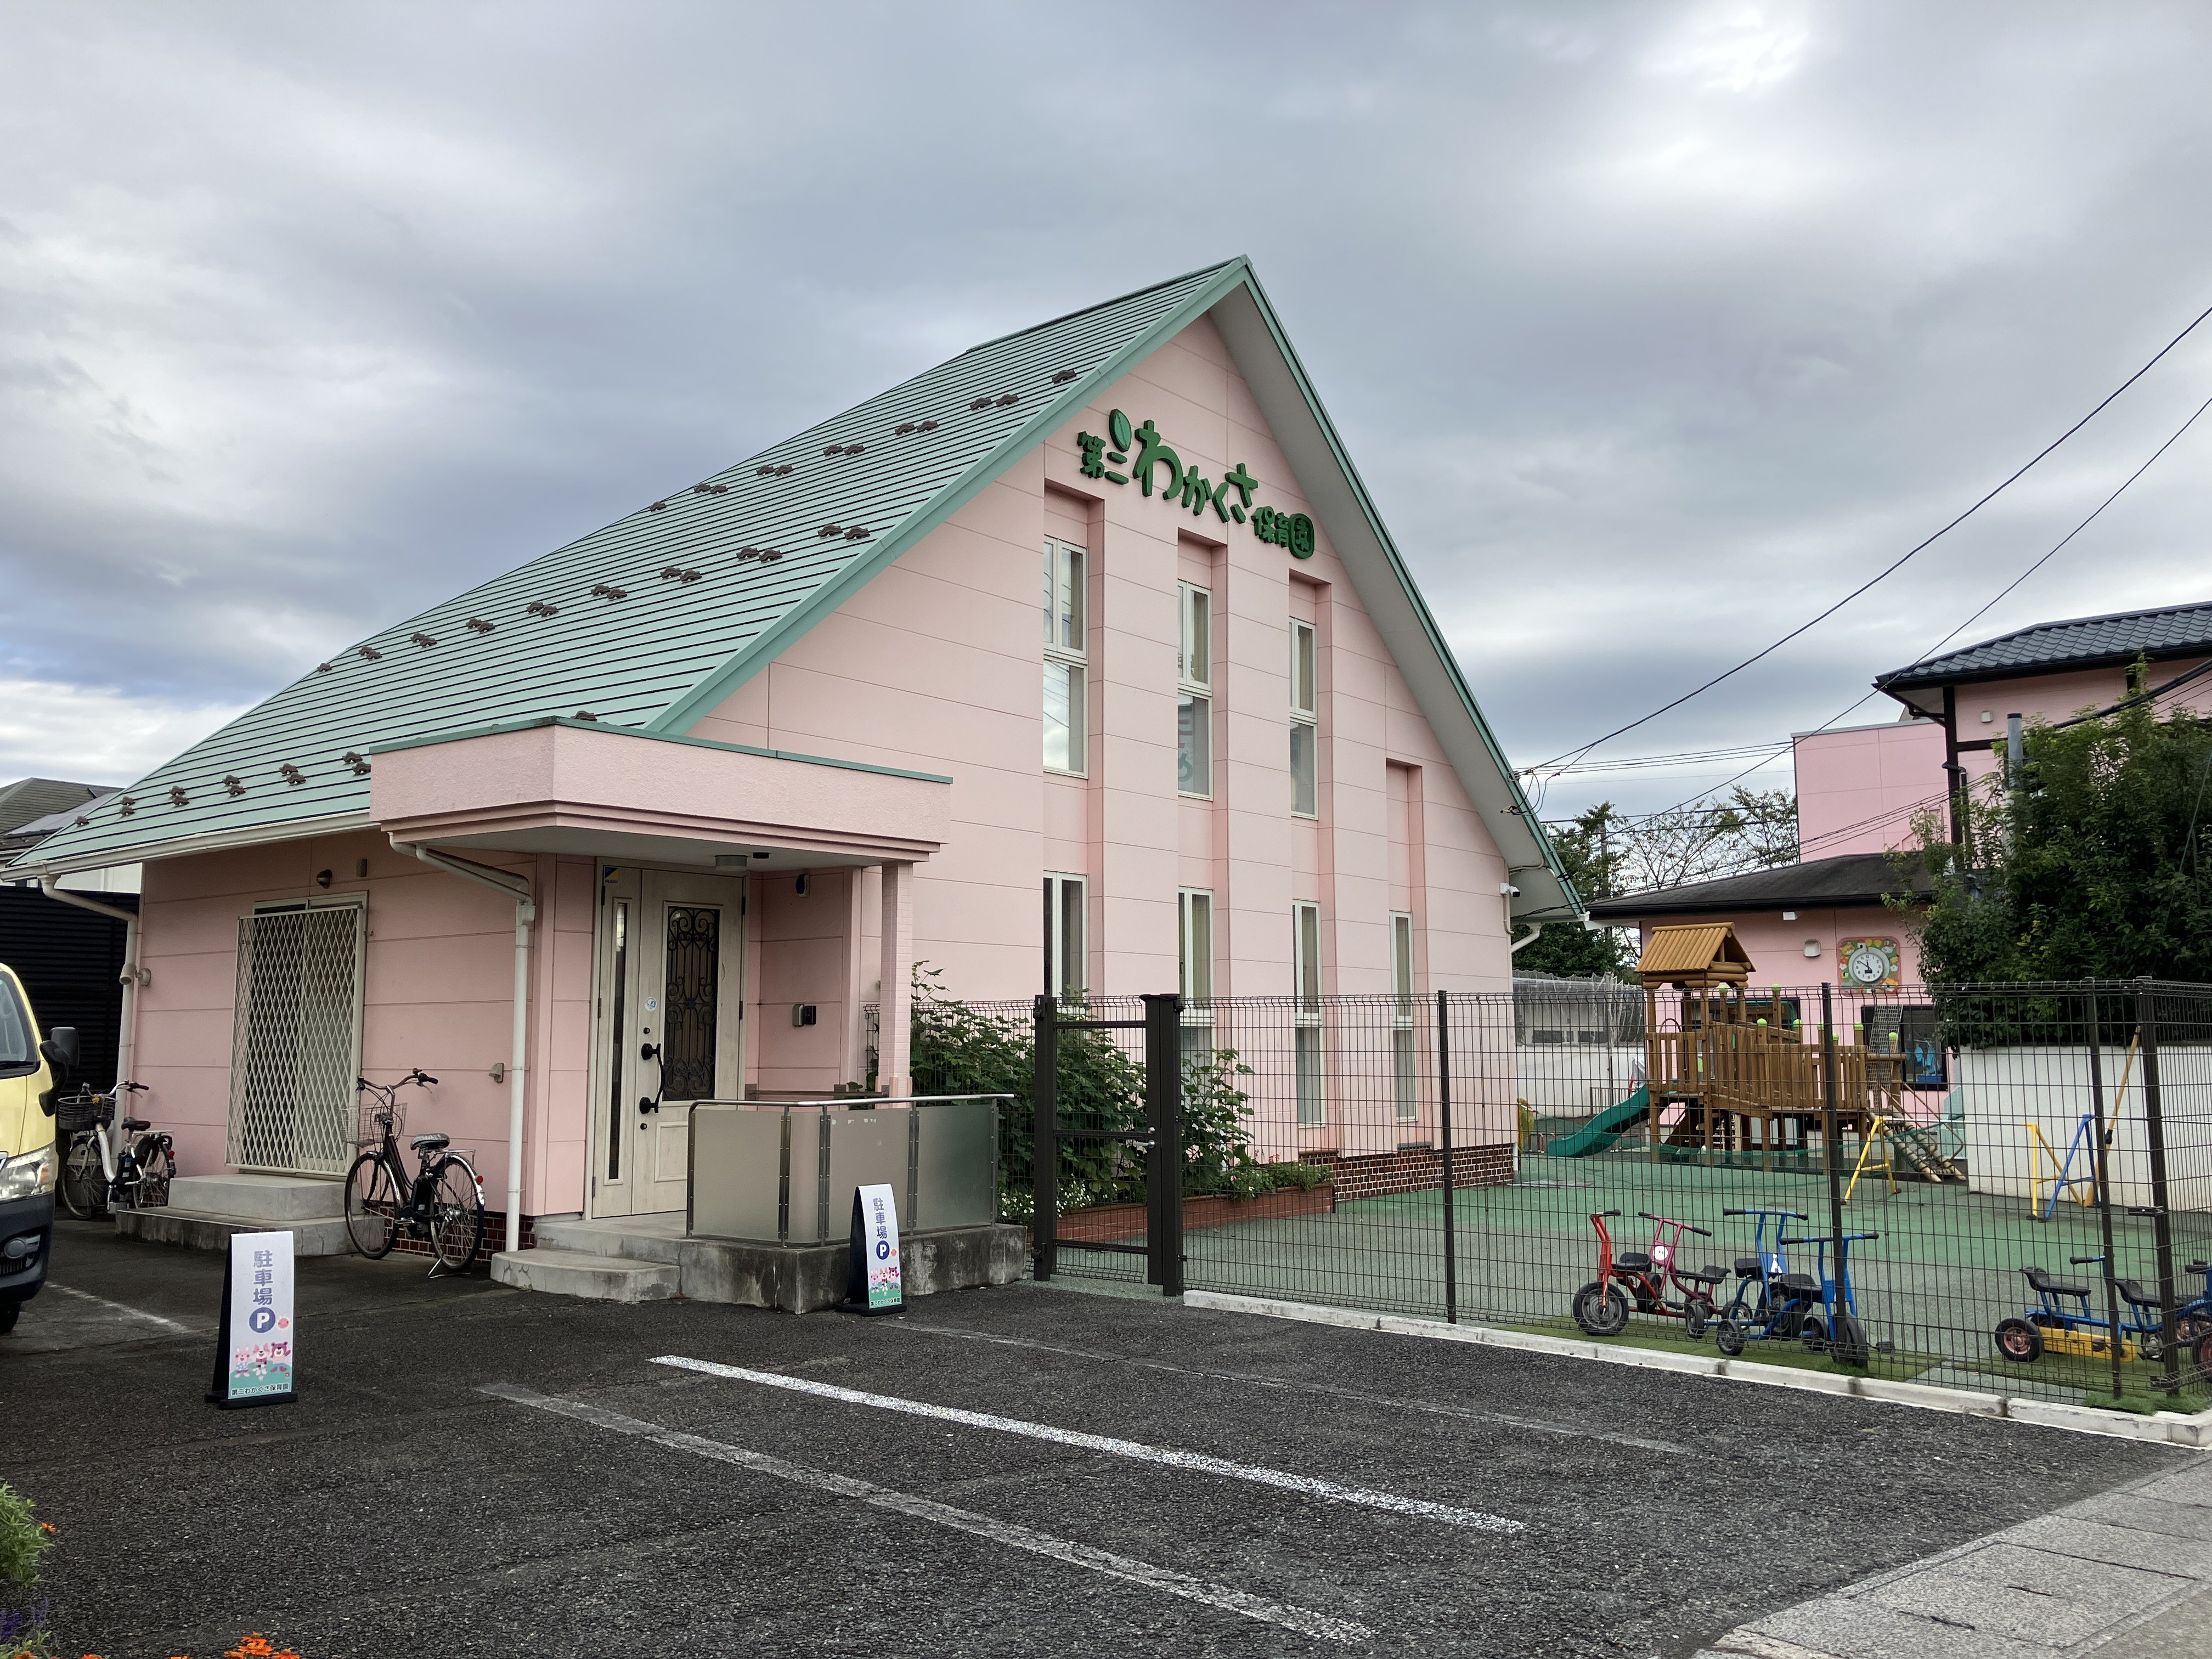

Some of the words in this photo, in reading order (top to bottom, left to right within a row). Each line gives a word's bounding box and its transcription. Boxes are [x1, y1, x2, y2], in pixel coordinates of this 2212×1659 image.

[1077, 419, 1314, 559] 第二わかくさ保育園
[873, 1197, 887, 1239] 駐車場
[253, 1250, 273, 1305] 駐車場
[232, 1383, 289, 1396] 第二わかくさ保育園
